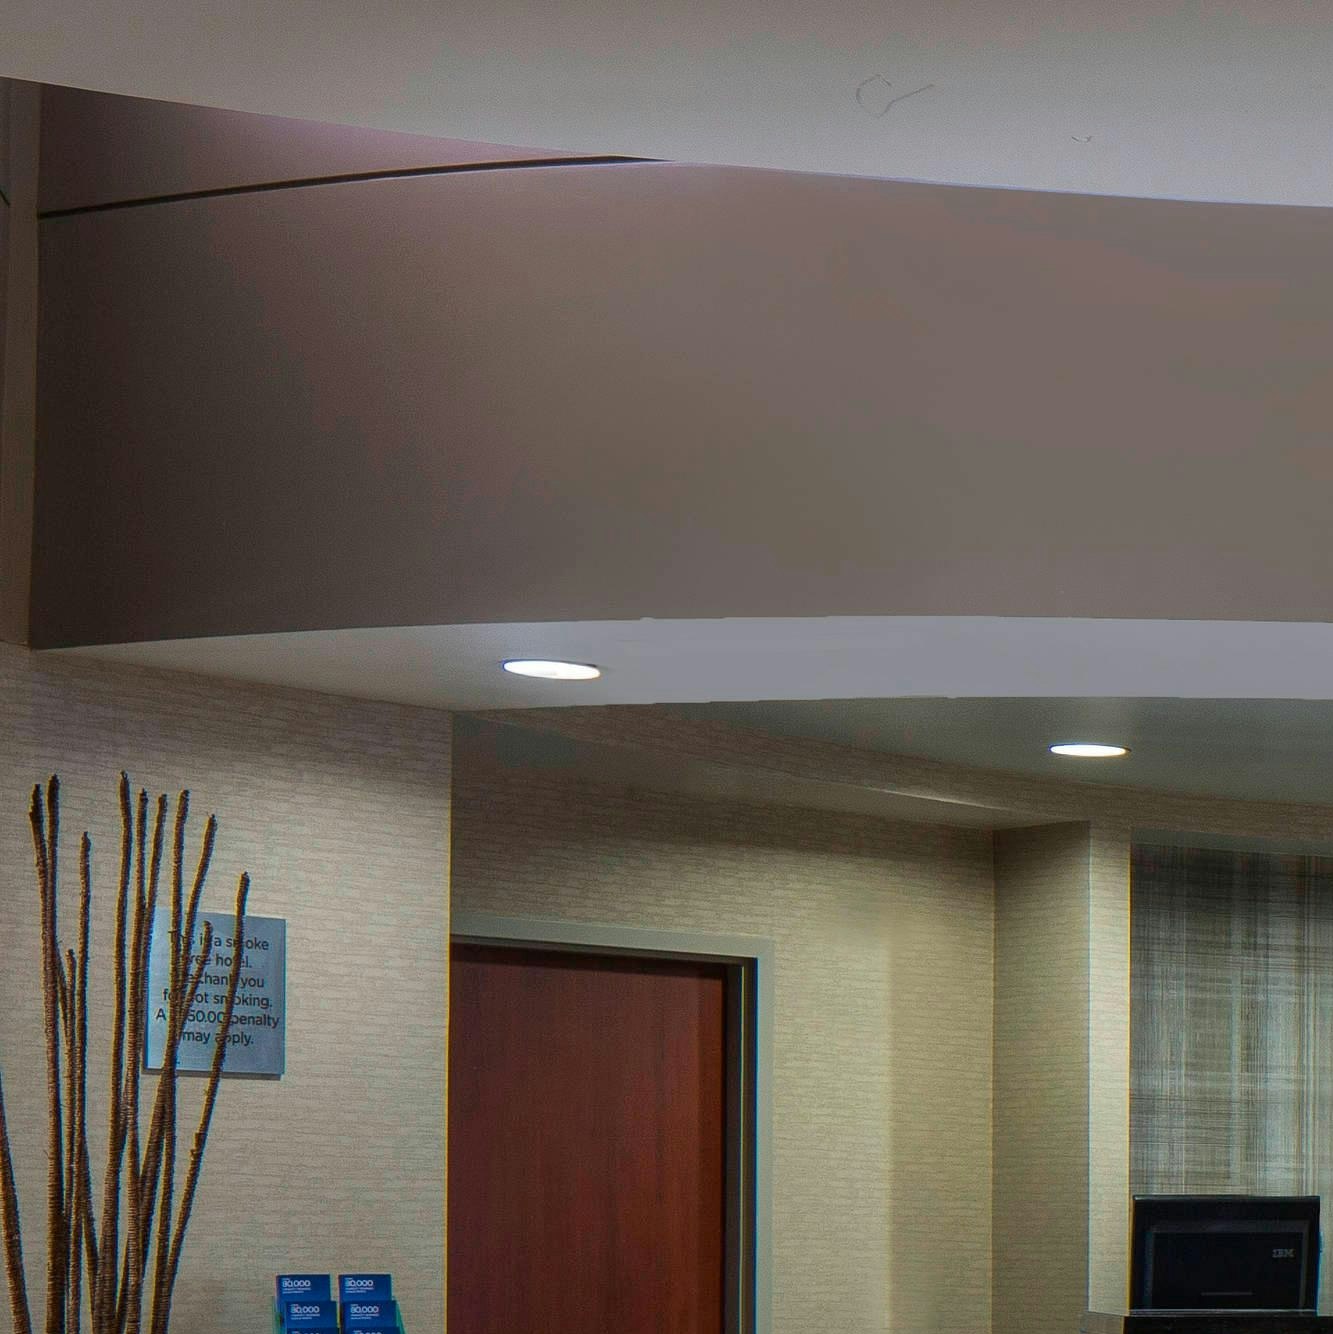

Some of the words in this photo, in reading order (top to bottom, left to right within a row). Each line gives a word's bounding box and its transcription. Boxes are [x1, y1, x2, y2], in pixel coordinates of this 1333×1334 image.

[213, 936, 222, 947] a
[225, 936, 270, 951] soke
[215, 953, 252, 969] hoel.
[240, 977, 265, 990] you
[187, 991, 209, 1004] ot
[156, 1007, 167, 1021] A
[169, 1008, 228, 1024] 50.00
[231, 1013, 280, 1029] penalty
[182, 1031, 211, 1045] may
